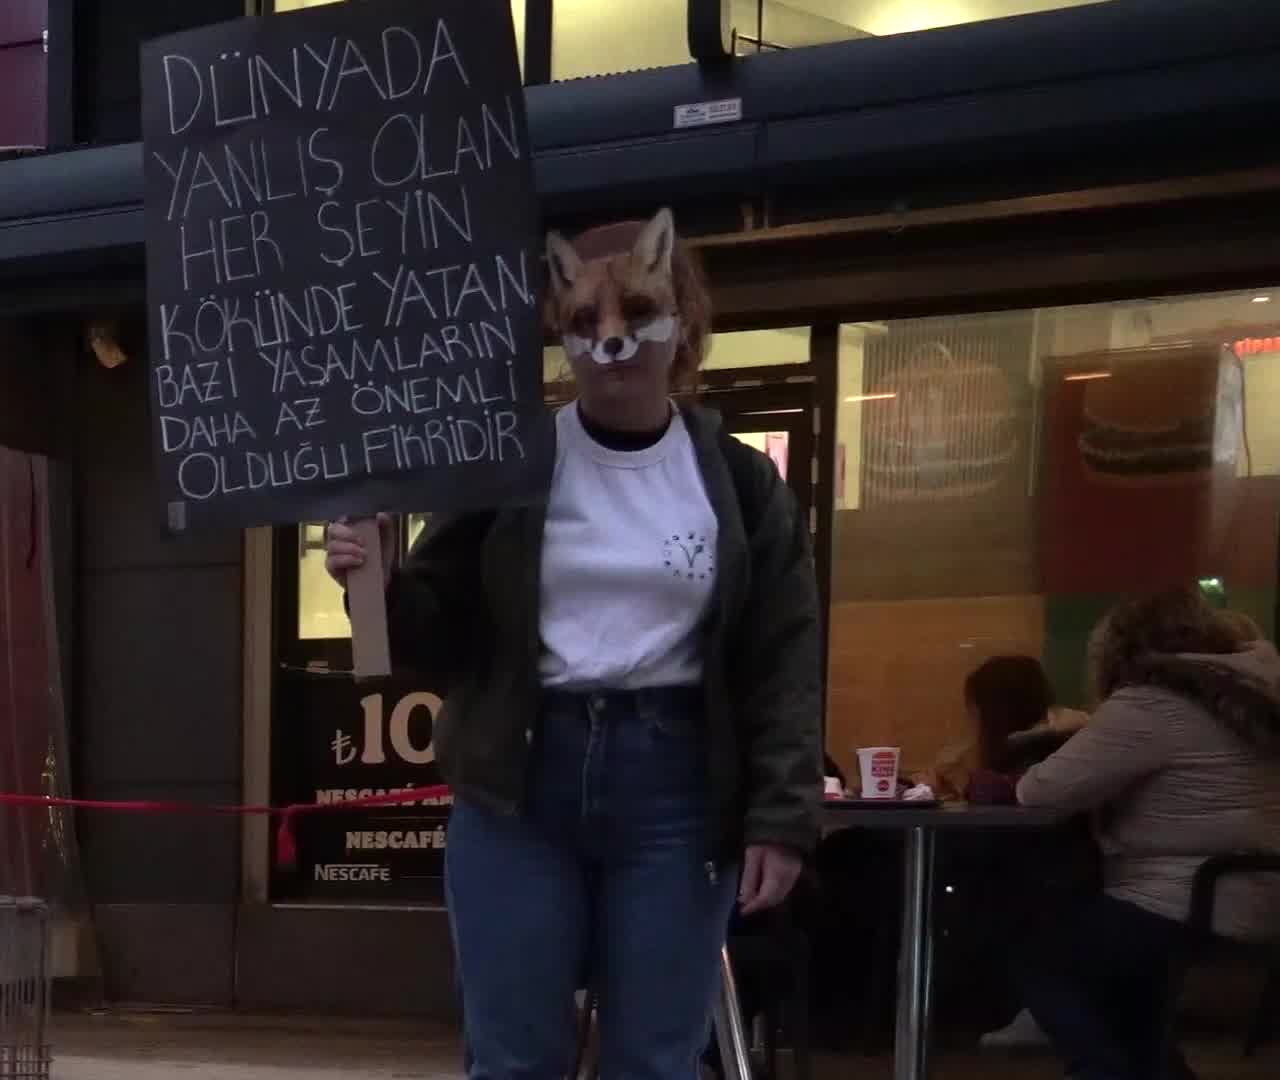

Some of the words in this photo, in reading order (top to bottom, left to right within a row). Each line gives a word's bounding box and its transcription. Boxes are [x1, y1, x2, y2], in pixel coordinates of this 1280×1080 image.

[162, 18, 471, 135] DÜNYADA
[153, 126, 344, 221] YANLIŞ
[371, 95, 521, 187] OLAN
[180, 210, 285, 291] HER
[316, 185, 473, 268] ŞEYİN
[159, 282, 365, 360] KÖKÜNDE
[155, 357, 239, 408] BAZI
[159, 412, 257, 453] DAHA
[275, 397, 327, 435] AZ
[351, 360, 519, 416] ÖNEMLİ
[177, 441, 350, 500] OLDUĞU
[345, 824, 447, 849] NESCAFÉ
